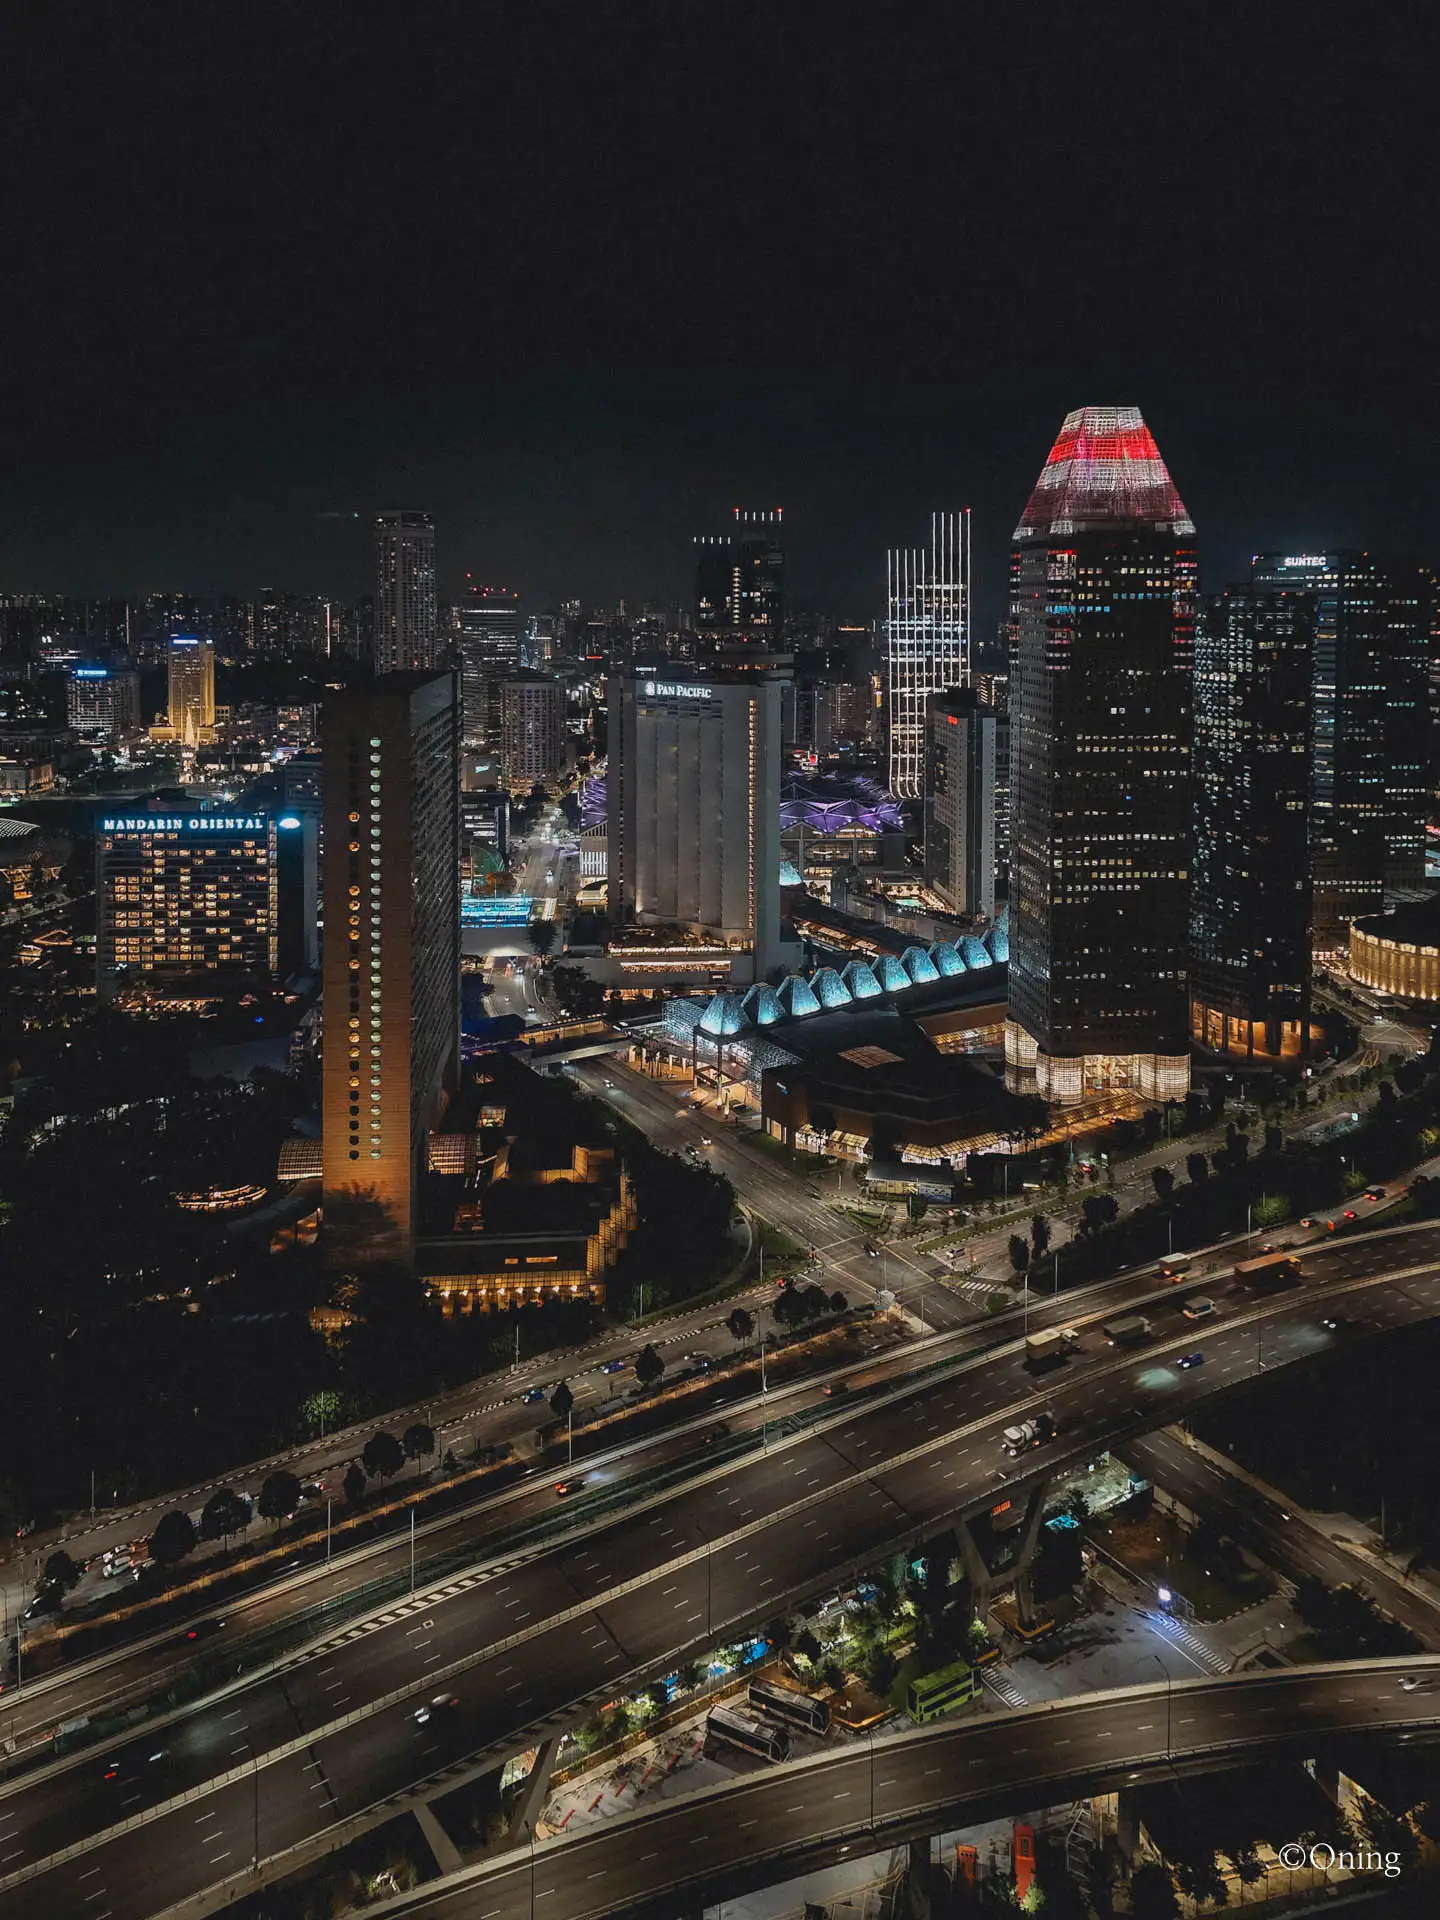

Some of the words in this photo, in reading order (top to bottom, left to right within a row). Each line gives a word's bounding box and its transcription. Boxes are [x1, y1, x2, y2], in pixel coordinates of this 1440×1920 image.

[1283, 556, 1327, 566] SUNTEC
[656, 683, 675, 696] PAN
[676, 685, 712, 698] PACIFIC
[104, 819, 183, 830] MANDARIN
[189, 818, 263, 830] ORIENTAL
